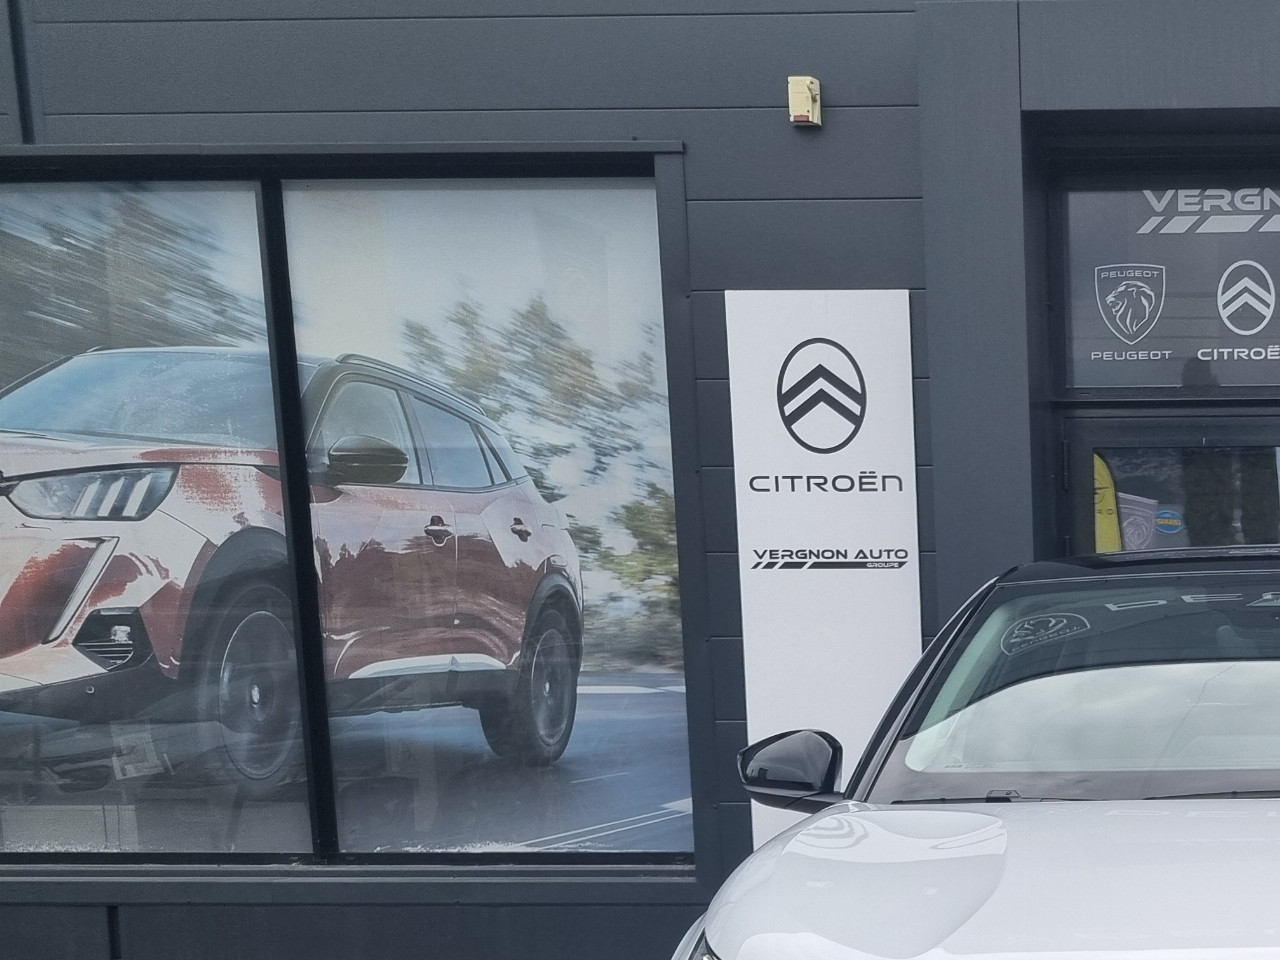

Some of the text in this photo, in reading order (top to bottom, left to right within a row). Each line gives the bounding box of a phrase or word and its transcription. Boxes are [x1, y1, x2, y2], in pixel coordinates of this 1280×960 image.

[1100, 270, 1160, 280] PEUGEOT
[1090, 350, 1173, 361] PEUGEOT
[752, 548, 909, 561] VERGNON AUTO
